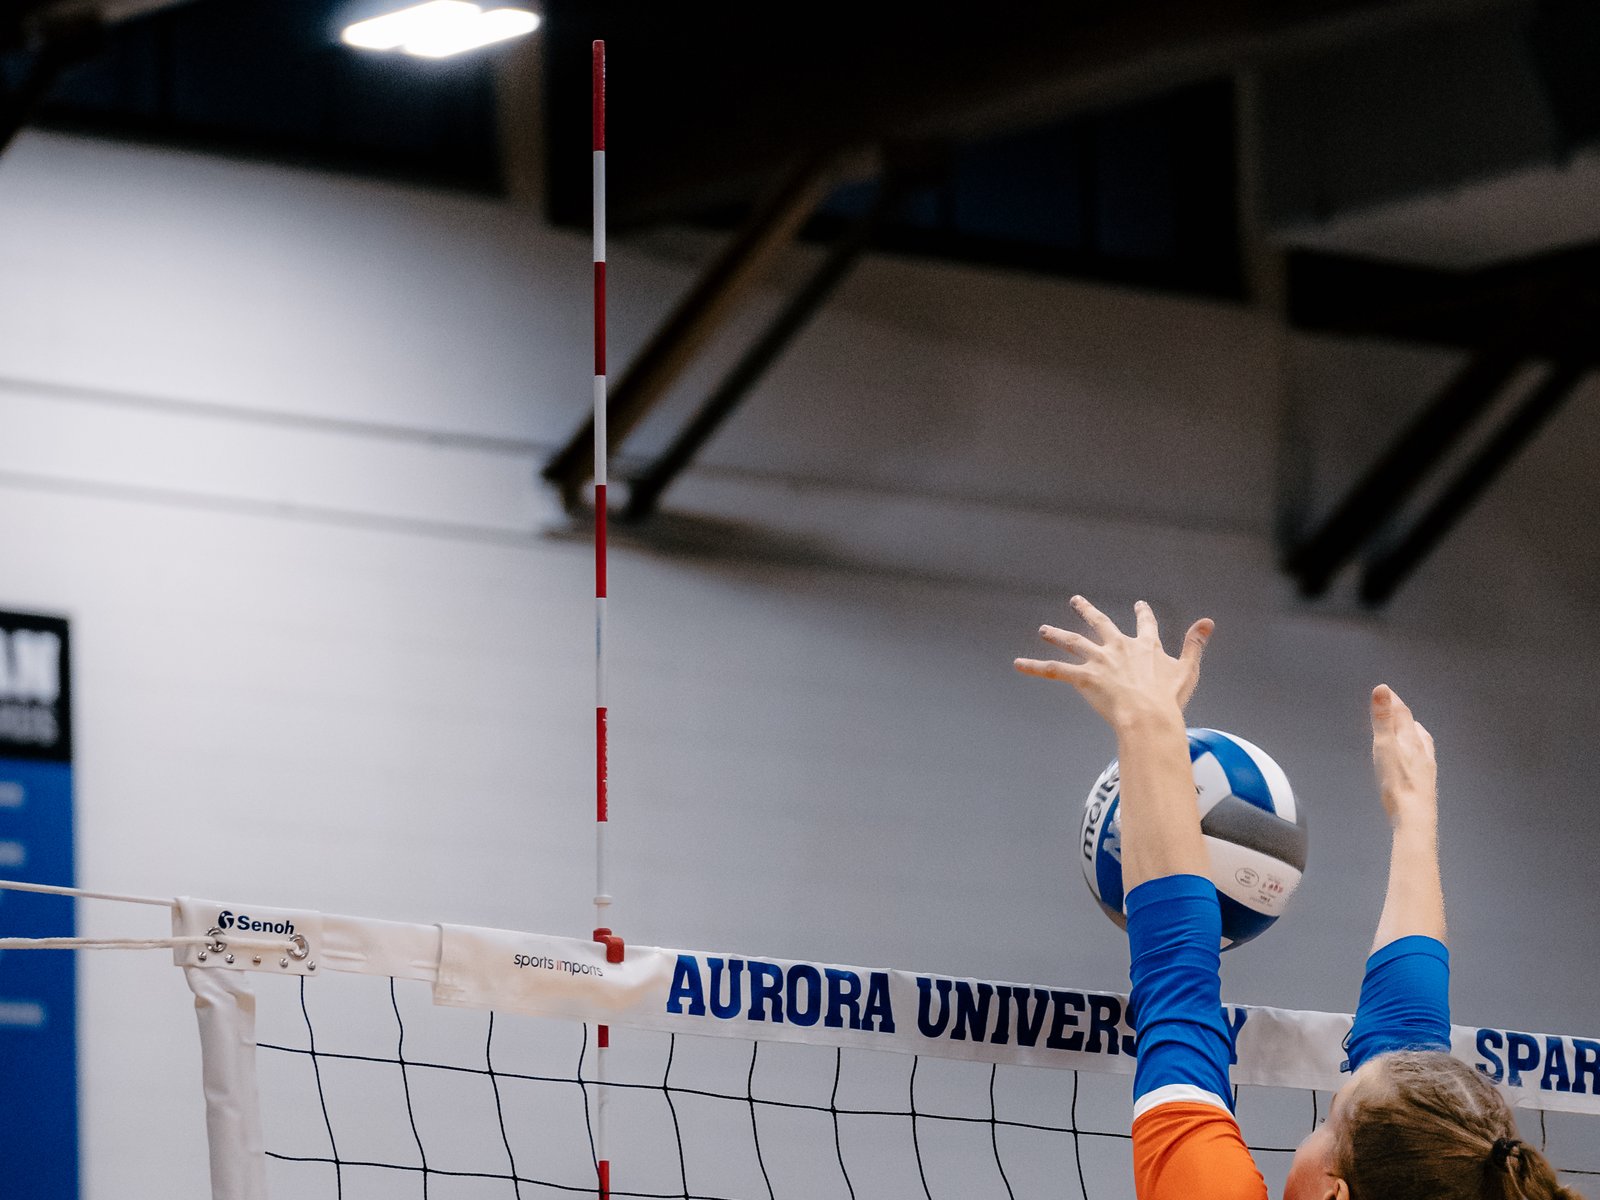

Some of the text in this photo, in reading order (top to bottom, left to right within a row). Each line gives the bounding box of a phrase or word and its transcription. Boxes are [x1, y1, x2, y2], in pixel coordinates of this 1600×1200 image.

[1083, 768, 1121, 862] molt
[236, 914, 295, 935] Senoh
[513, 953, 604, 977] sports imports
[665, 954, 1248, 1065] AURORA UNIVERY
[1475, 1027, 1600, 1096] SPAR
